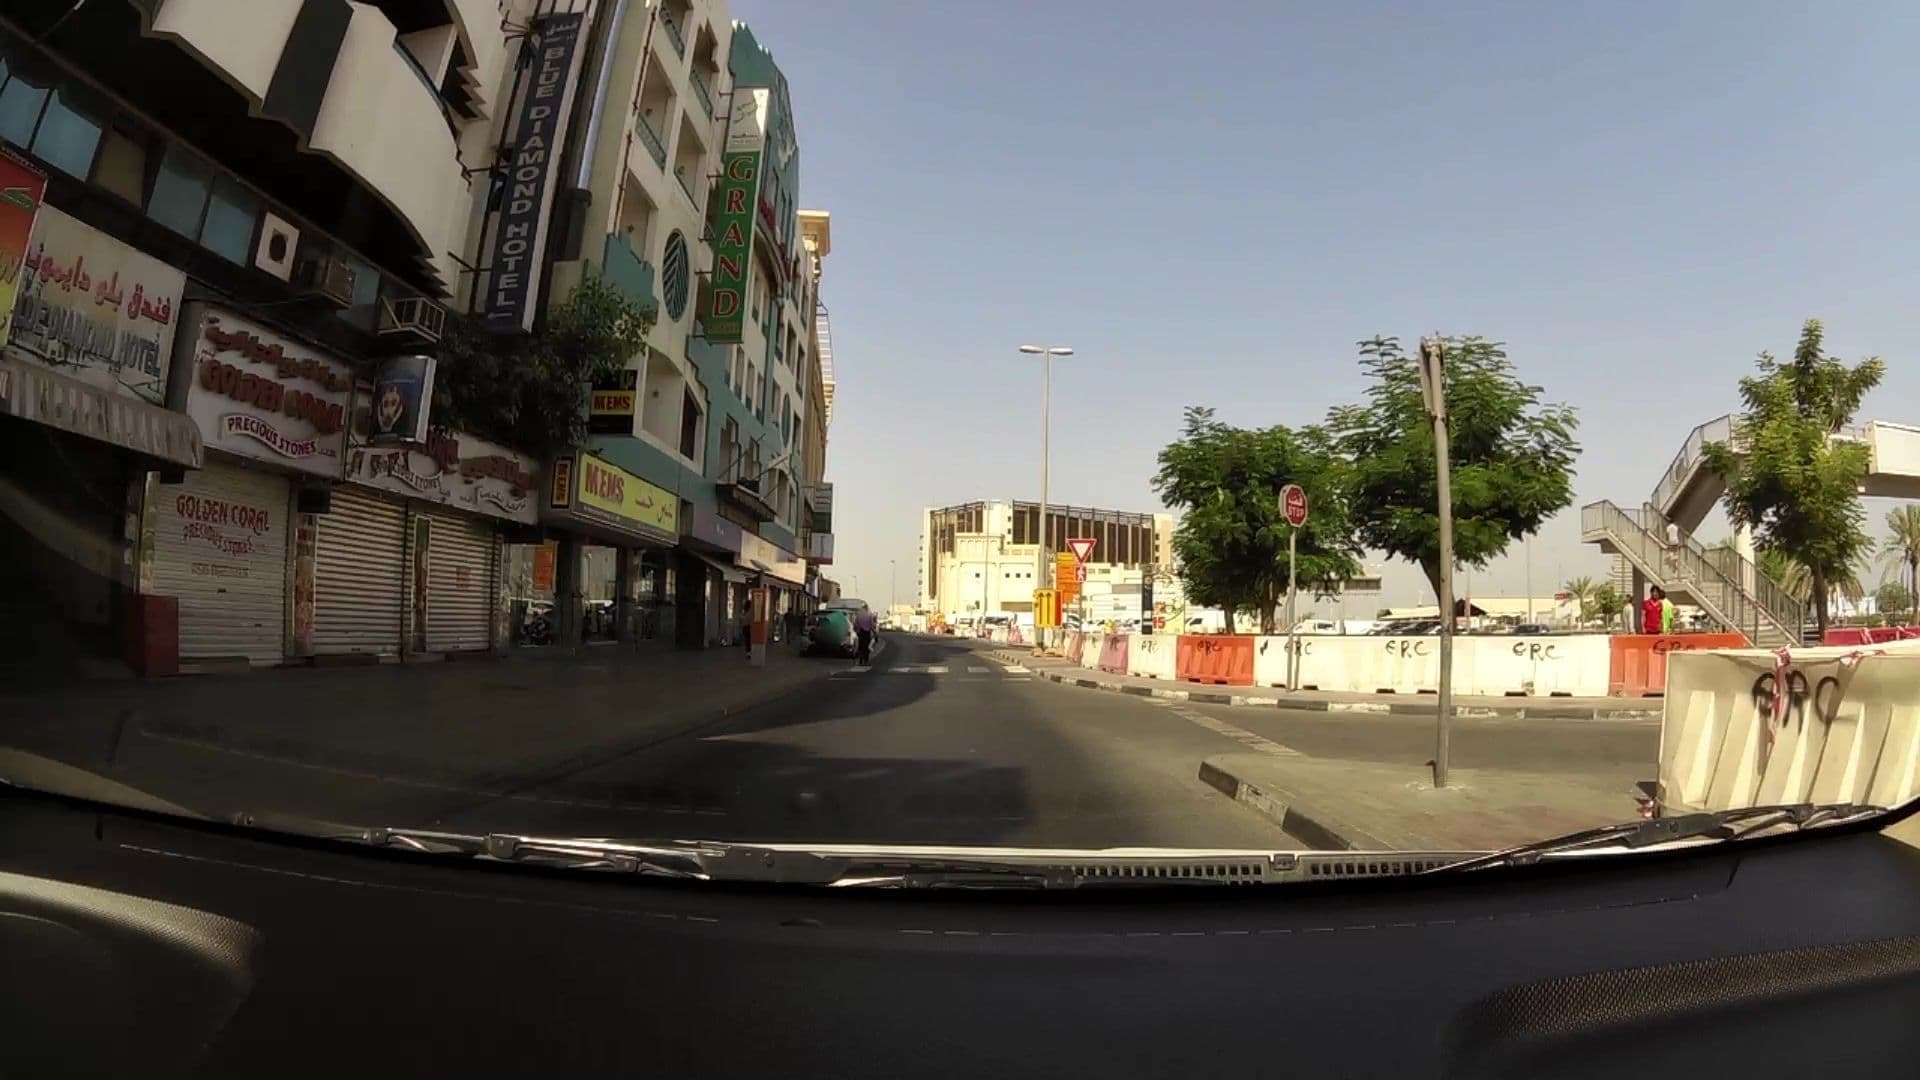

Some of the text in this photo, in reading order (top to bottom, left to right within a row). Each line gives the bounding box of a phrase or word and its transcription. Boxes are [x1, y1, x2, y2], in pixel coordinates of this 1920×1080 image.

[536, 47, 565, 98] BLUE
[511, 105, 550, 215] DIAMOND
[711, 156, 755, 319] GRAND
[497, 222, 528, 307] HOTEL
[127, 282, 171, 325] فندق
[228, 417, 316, 456] PRECIOUS STONES
[176, 495, 269, 536] GOLDEN CORAL
[1288, 506, 1304, 518] STOP
